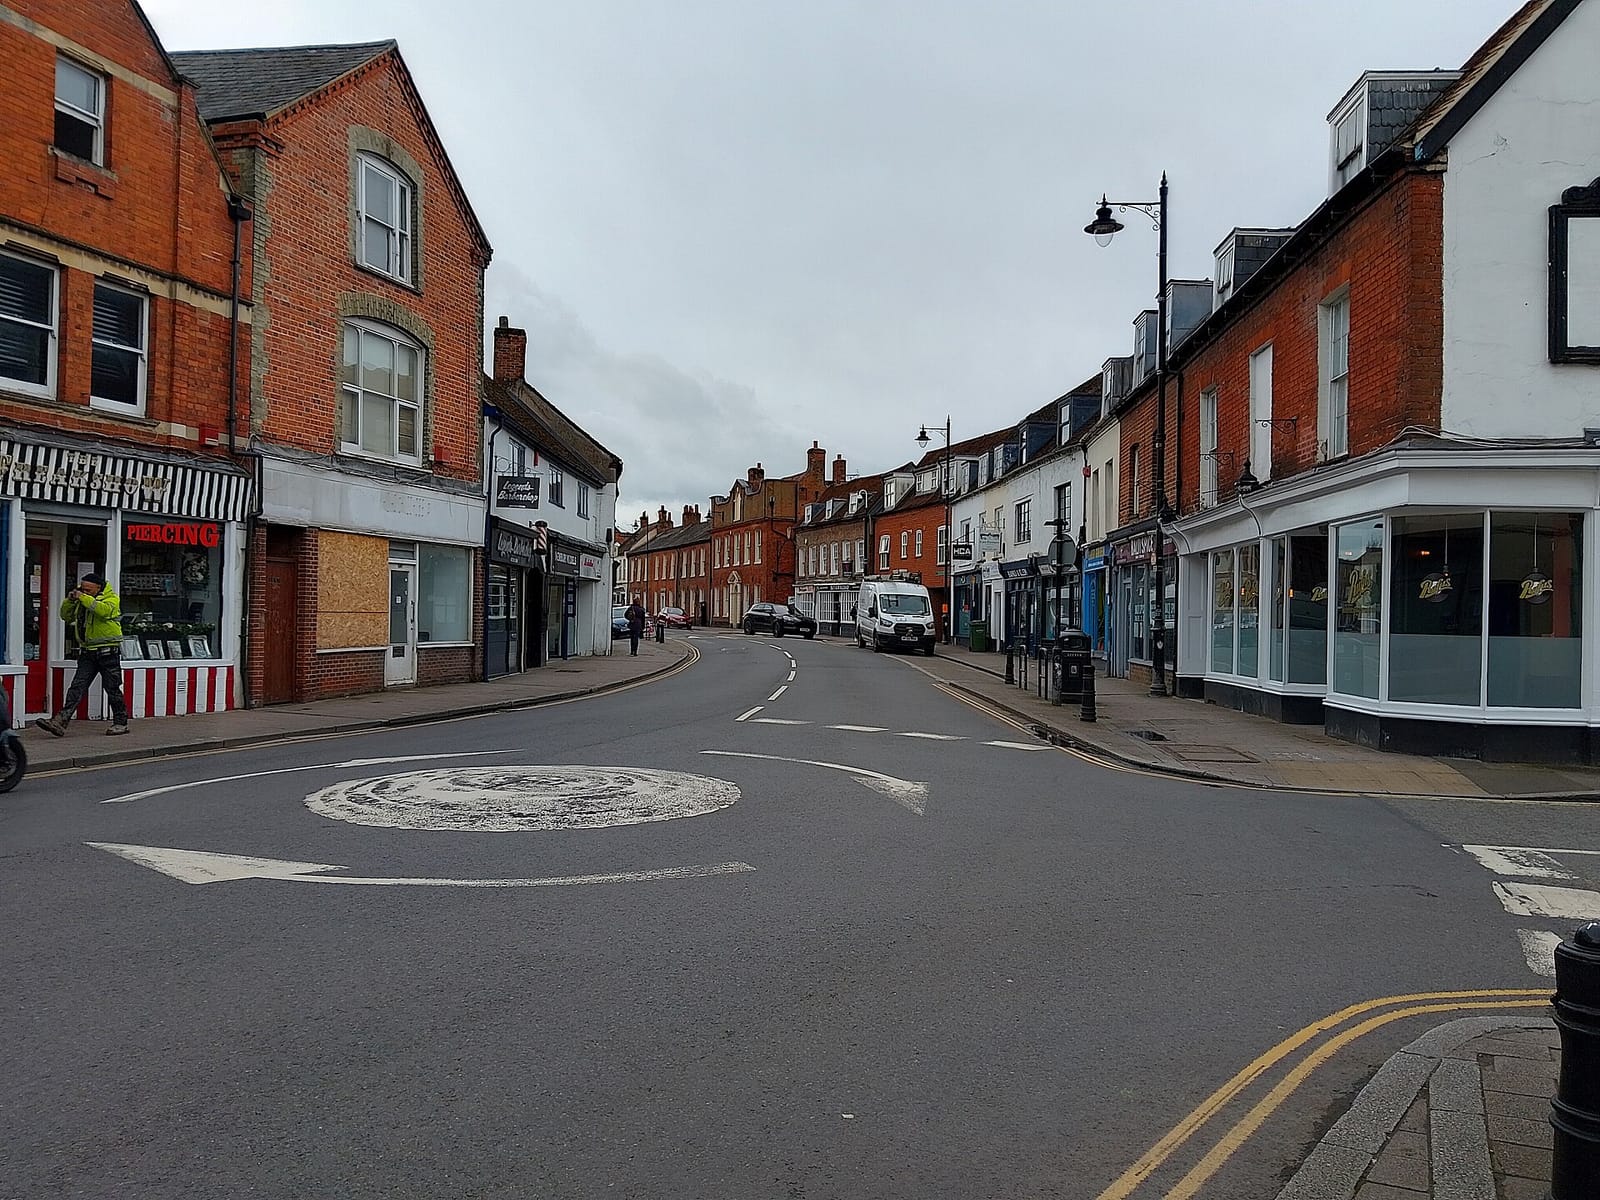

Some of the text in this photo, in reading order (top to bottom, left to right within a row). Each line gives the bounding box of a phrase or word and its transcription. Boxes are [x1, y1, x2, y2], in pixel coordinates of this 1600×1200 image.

[67, 452, 99, 467] THE
[127, 522, 220, 548] PIERCING
[1418, 577, 1454, 599] Rufus
[1519, 578, 1555, 599] Rufus
